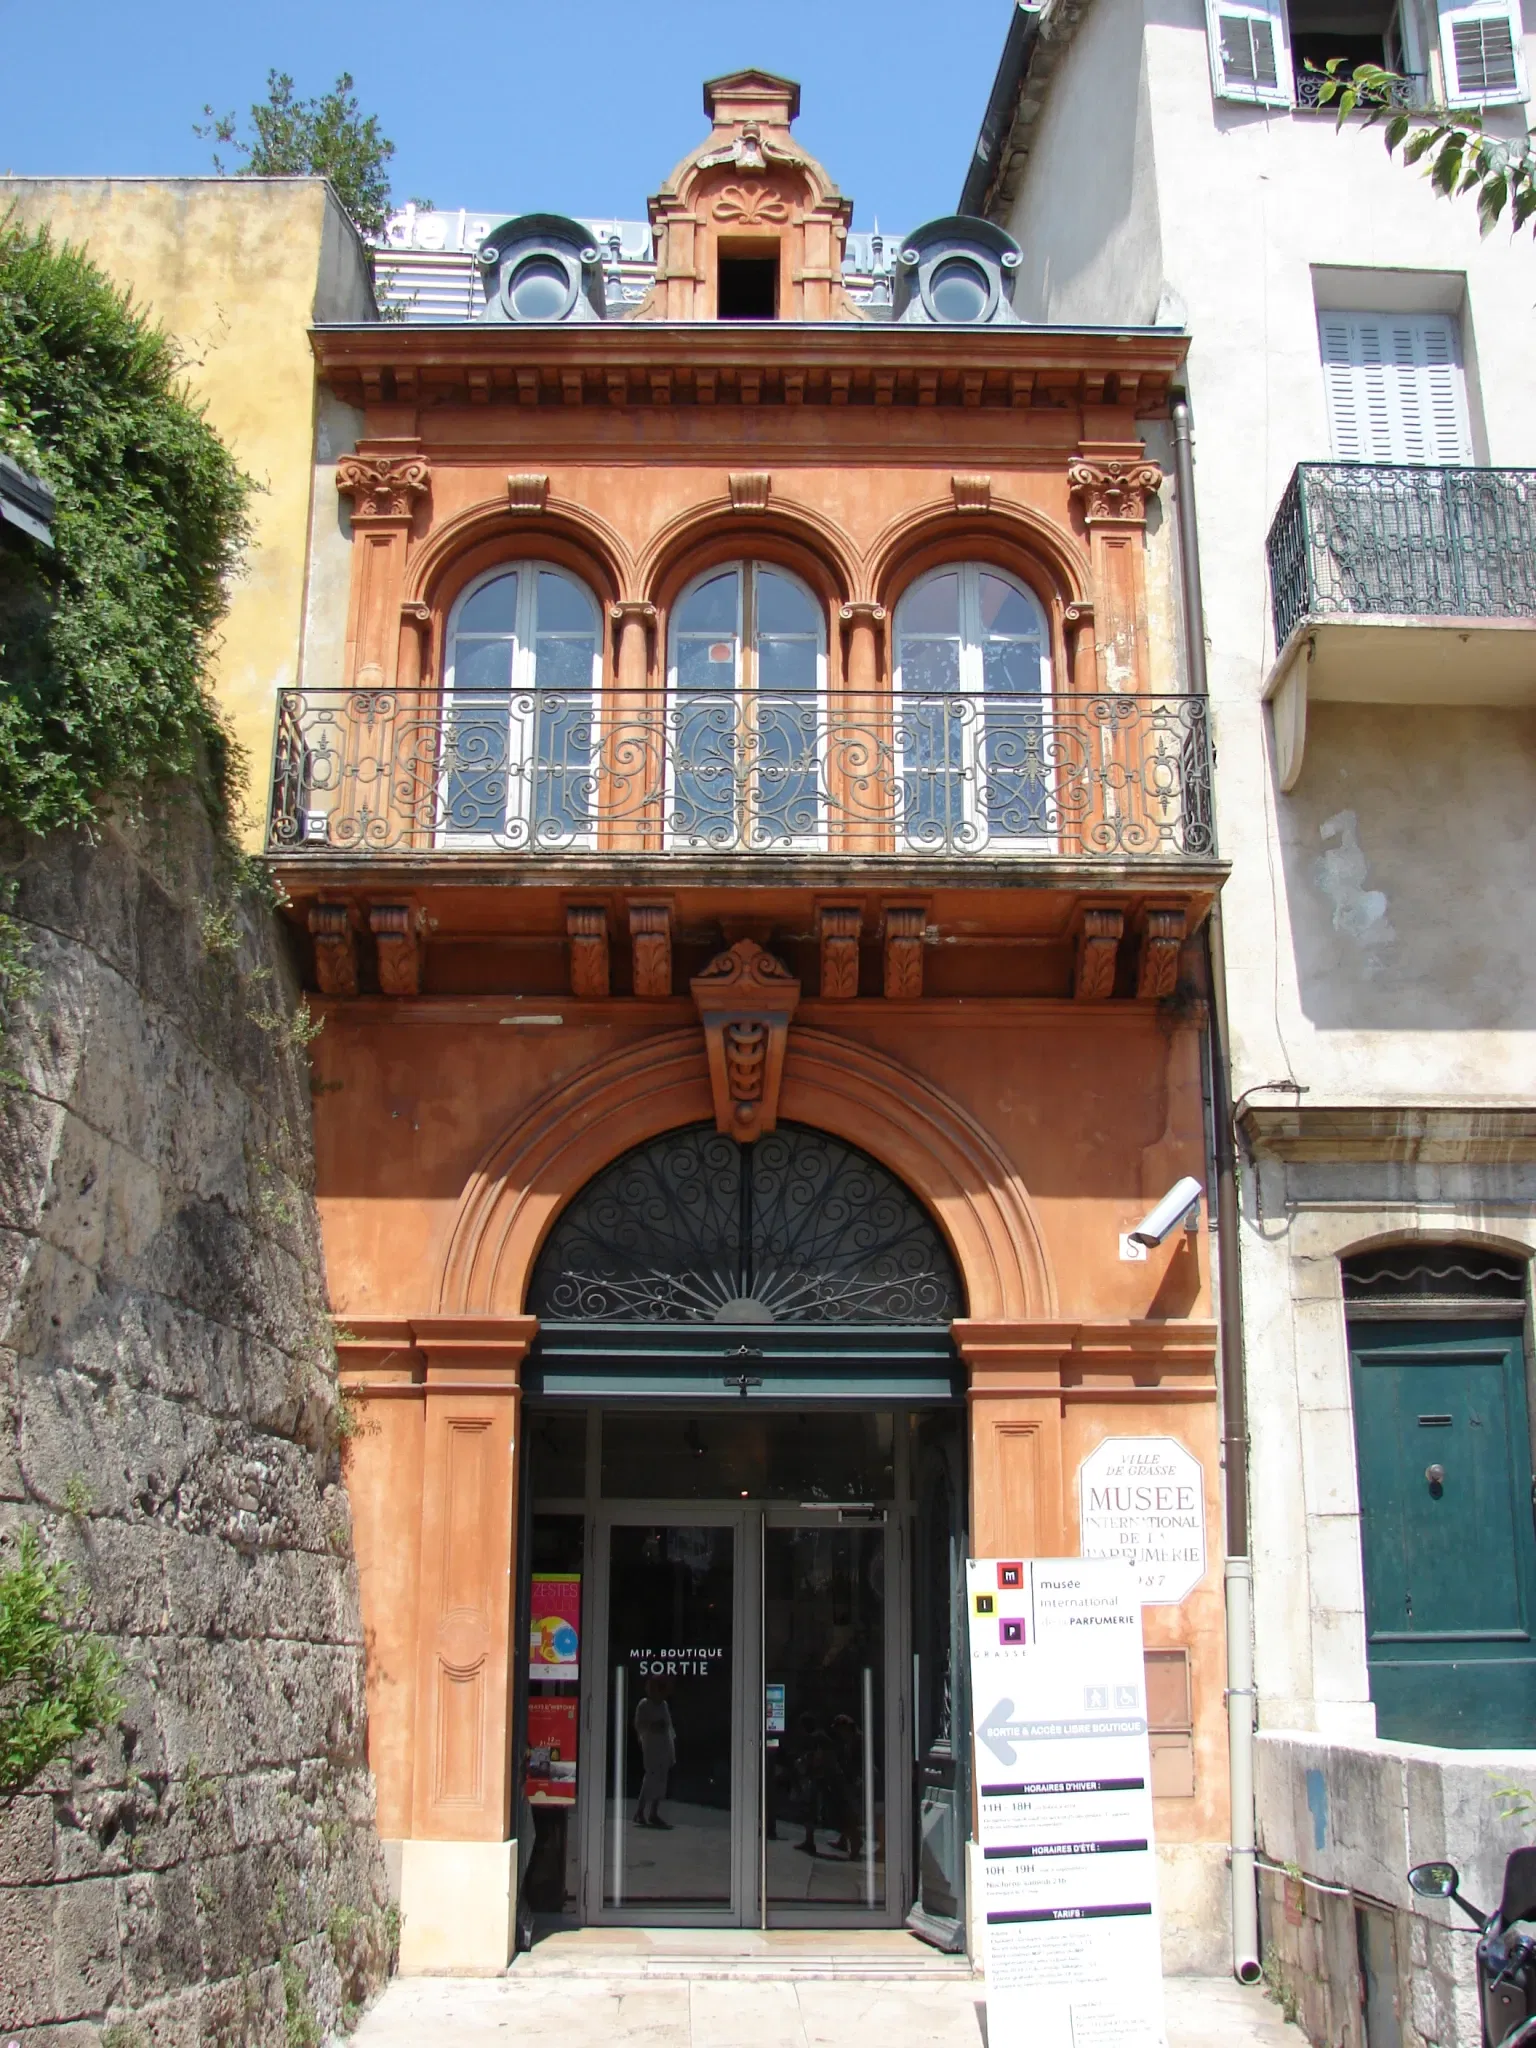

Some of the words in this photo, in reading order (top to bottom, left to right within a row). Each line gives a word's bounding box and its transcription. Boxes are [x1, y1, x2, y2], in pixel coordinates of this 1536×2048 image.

[1121, 1454, 1160, 1464] VILLE
[1106, 1466, 1124, 1476] DE
[1128, 1466, 1176, 1476] GRASSE
[1089, 1486, 1195, 1512] MUSEE
[1120, 1532, 1140, 1544] DE
[1040, 1579, 1081, 1590] musée
[1070, 1616, 1134, 1626] PARFUMERIE
[660, 1648, 723, 1658] BOUTIQUE
[639, 1661, 709, 1676] SORTIE
[987, 1728, 1020, 1737] SORTIE
[1063, 1724, 1091, 1734] LIBRE
[1092, 1722, 1141, 1733] BOUTIQUE
[1024, 1784, 1064, 1792] HORAIRES
[982, 1803, 1002, 1812] 11H
[1012, 1802, 1032, 1811] 18H
[1032, 1846, 1072, 1854] HORAIRES
[985, 1866, 1004, 1876] 10H
[1015, 1864, 1034, 1874] 19H
[1053, 1910, 1080, 1918] TARIFS
